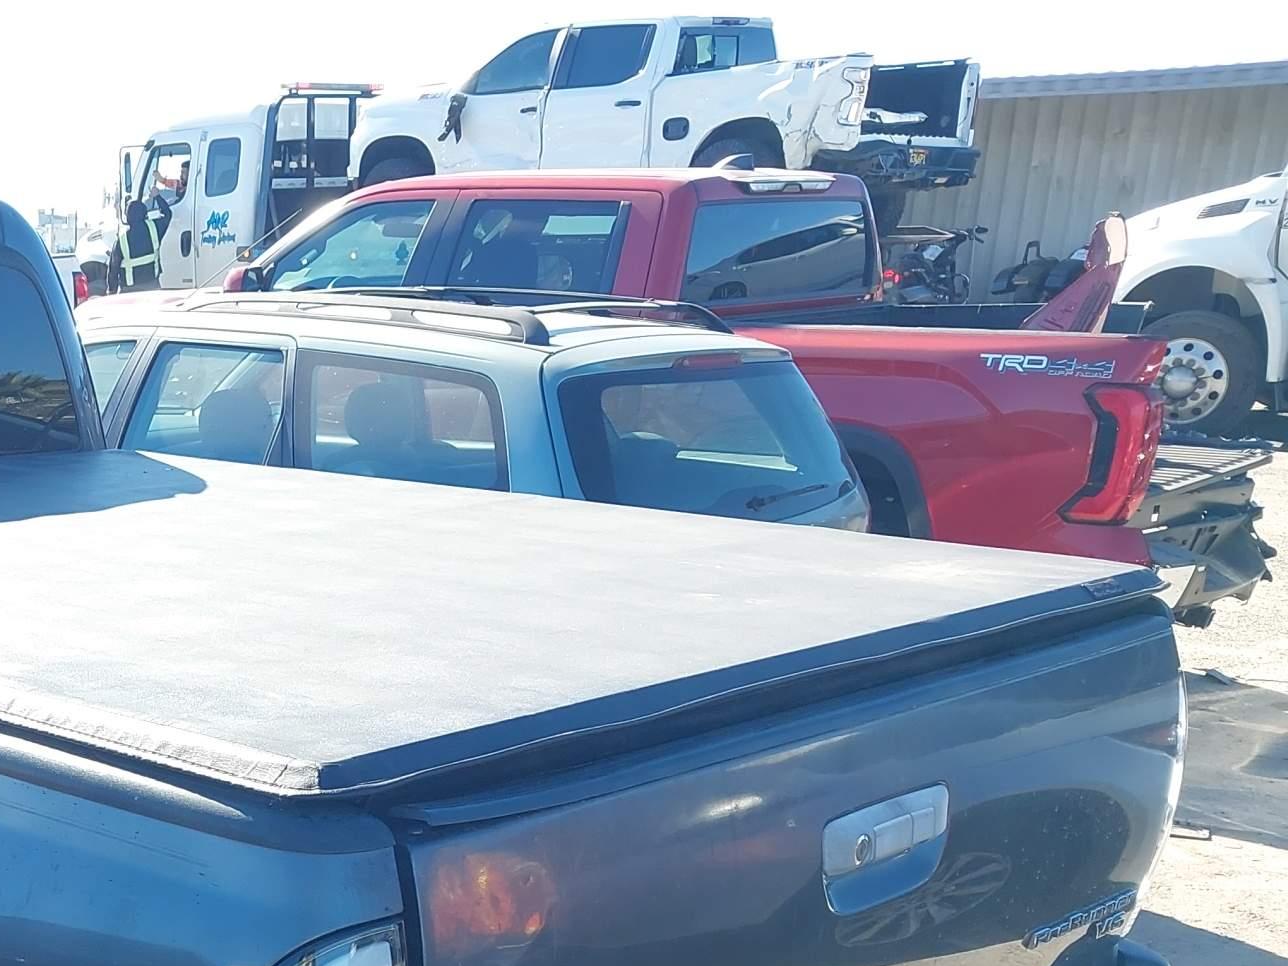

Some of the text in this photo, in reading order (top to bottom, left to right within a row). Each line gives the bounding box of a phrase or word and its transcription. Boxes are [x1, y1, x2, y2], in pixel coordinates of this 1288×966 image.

[979, 353, 1048, 373] TRD
[1031, 889, 1138, 947] PreRunner
[1095, 911, 1126, 940] V6
